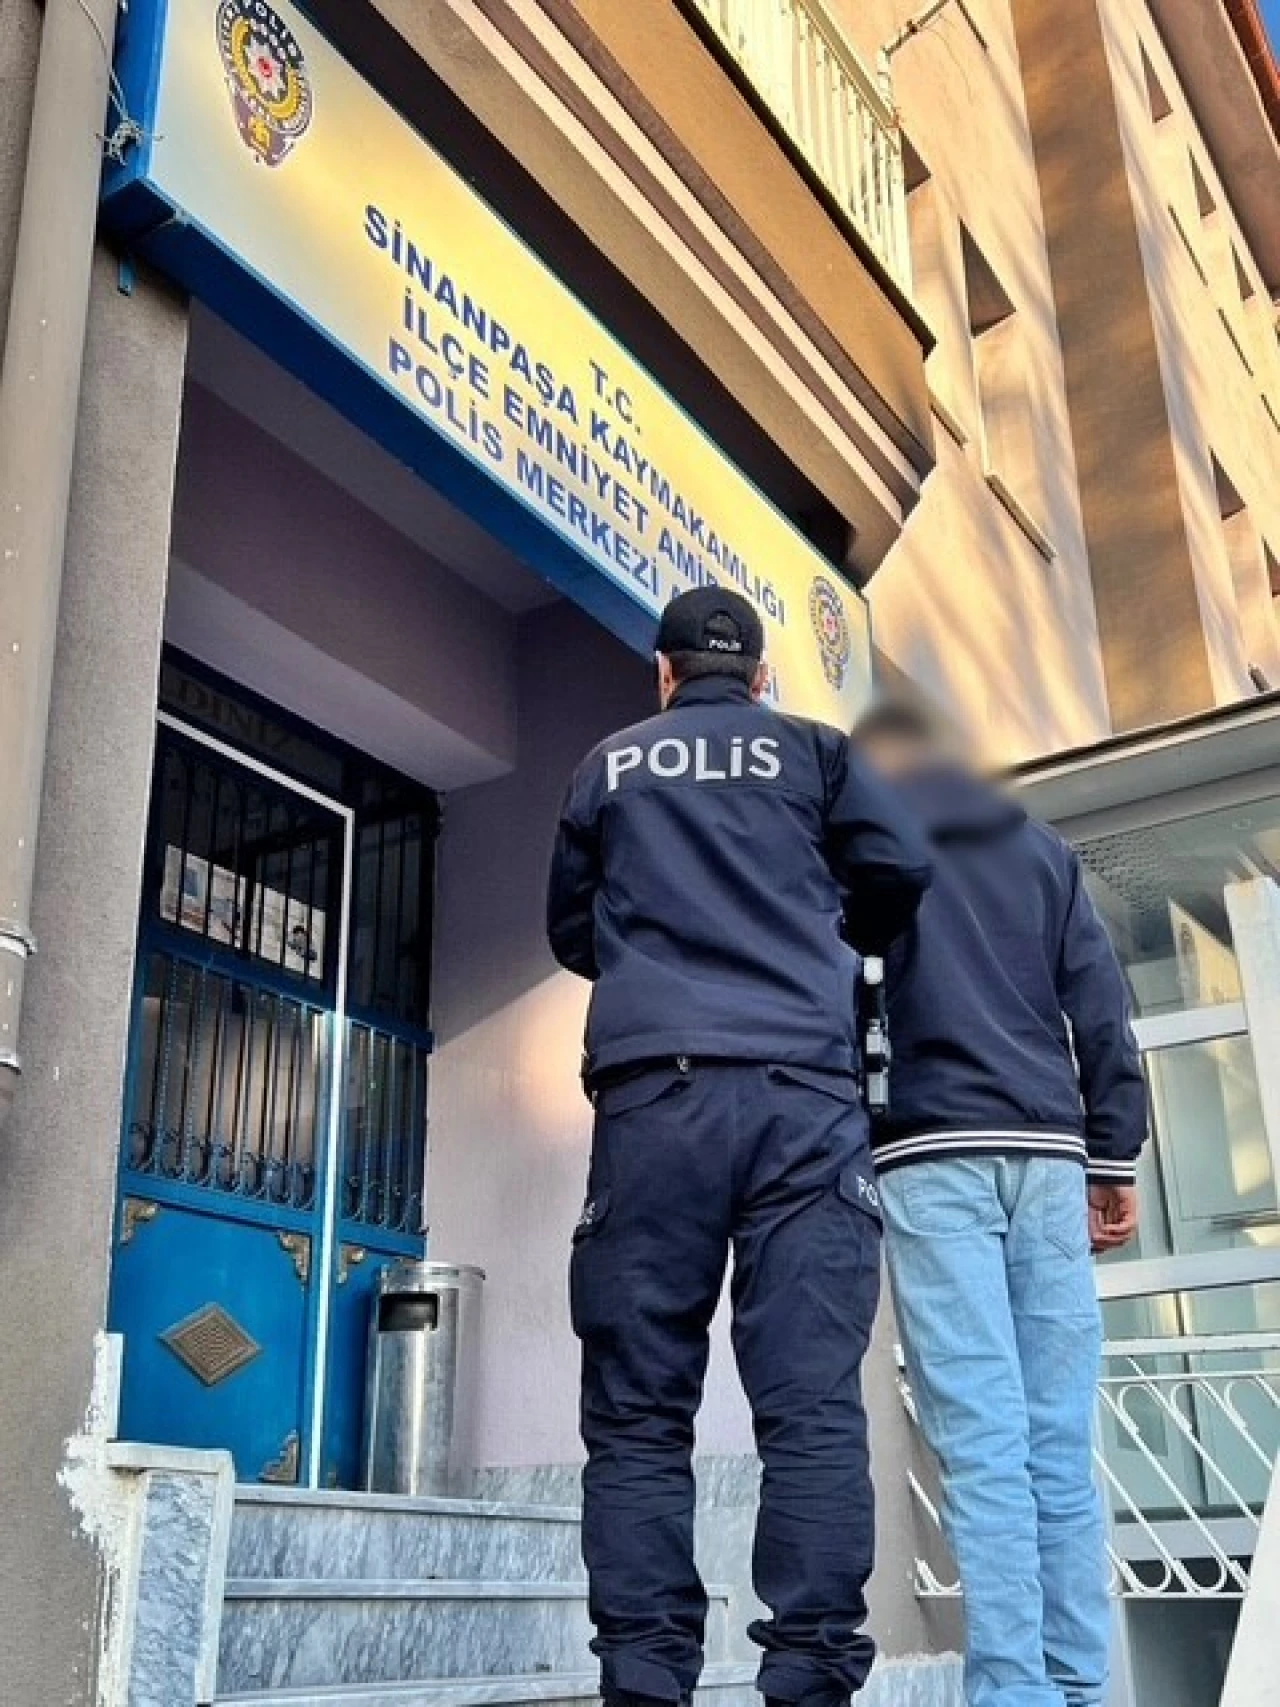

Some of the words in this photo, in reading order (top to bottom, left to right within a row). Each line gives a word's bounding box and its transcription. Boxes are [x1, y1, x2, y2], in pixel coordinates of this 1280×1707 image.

[364, 204, 579, 427] SİNANPAŞA
[590, 408, 785, 627] KAYMAKAMLIĞI
[388, 335, 503, 462] POLİS
[516, 448, 659, 596] MERKEZİ
[404, 286, 489, 398] İLÇE
[503, 383, 648, 534] EMNİYET
[588, 358, 641, 434] T.C.
[607, 736, 782, 792] POLİS
